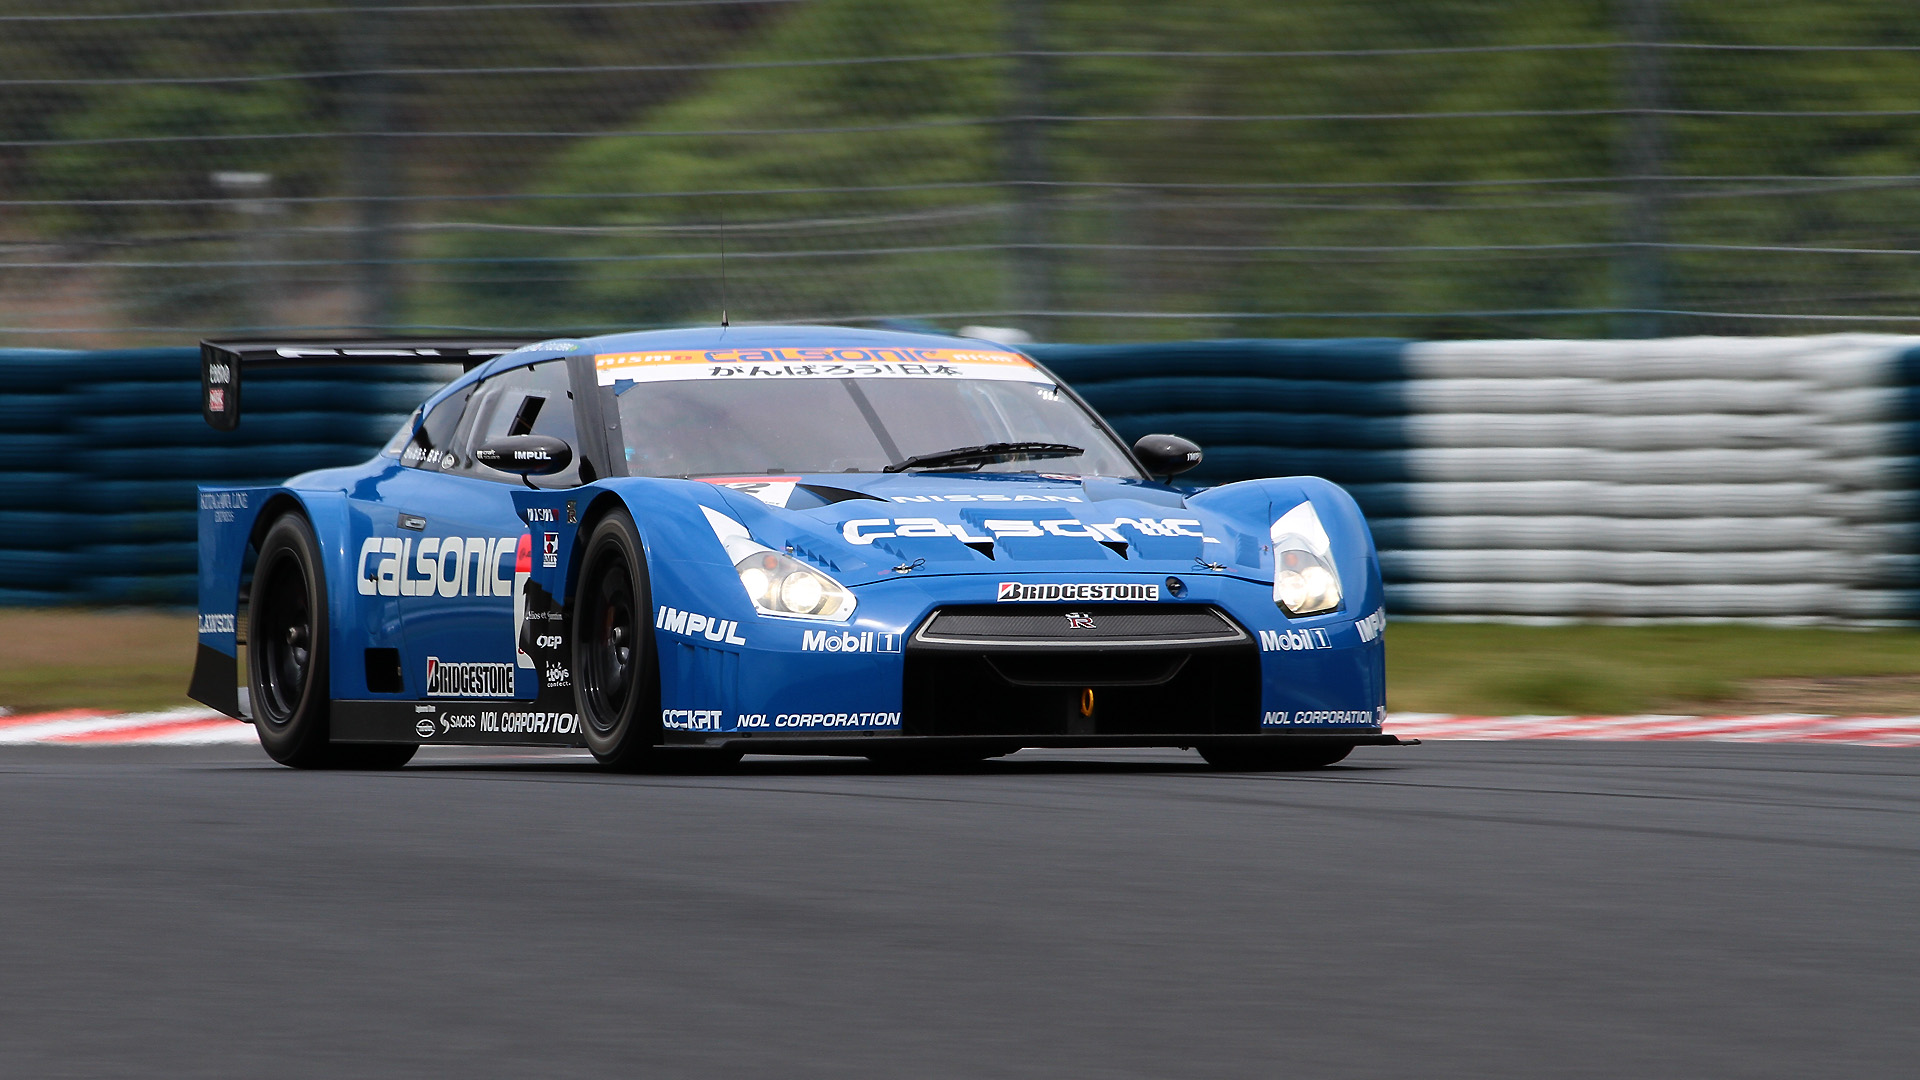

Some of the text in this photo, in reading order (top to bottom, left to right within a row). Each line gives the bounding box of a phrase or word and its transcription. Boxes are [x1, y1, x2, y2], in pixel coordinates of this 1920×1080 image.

[513, 450, 552, 460] IMPUL
[889, 493, 1084, 504] NISSAN
[997, 582, 1159, 602] BRIDGESTONE
[656, 605, 747, 646] IMPUL
[802, 630, 873, 652] Mobil
[1258, 628, 1315, 652] Mobil
[427, 656, 515, 697] BRIDGESTONE
[449, 715, 476, 728] SACHS
[480, 711, 499, 732] NOL
[736, 712, 901, 728] NOL CORPORATION
[1263, 711, 1291, 725] NOL
[1294, 711, 1373, 724] CORPORATION
